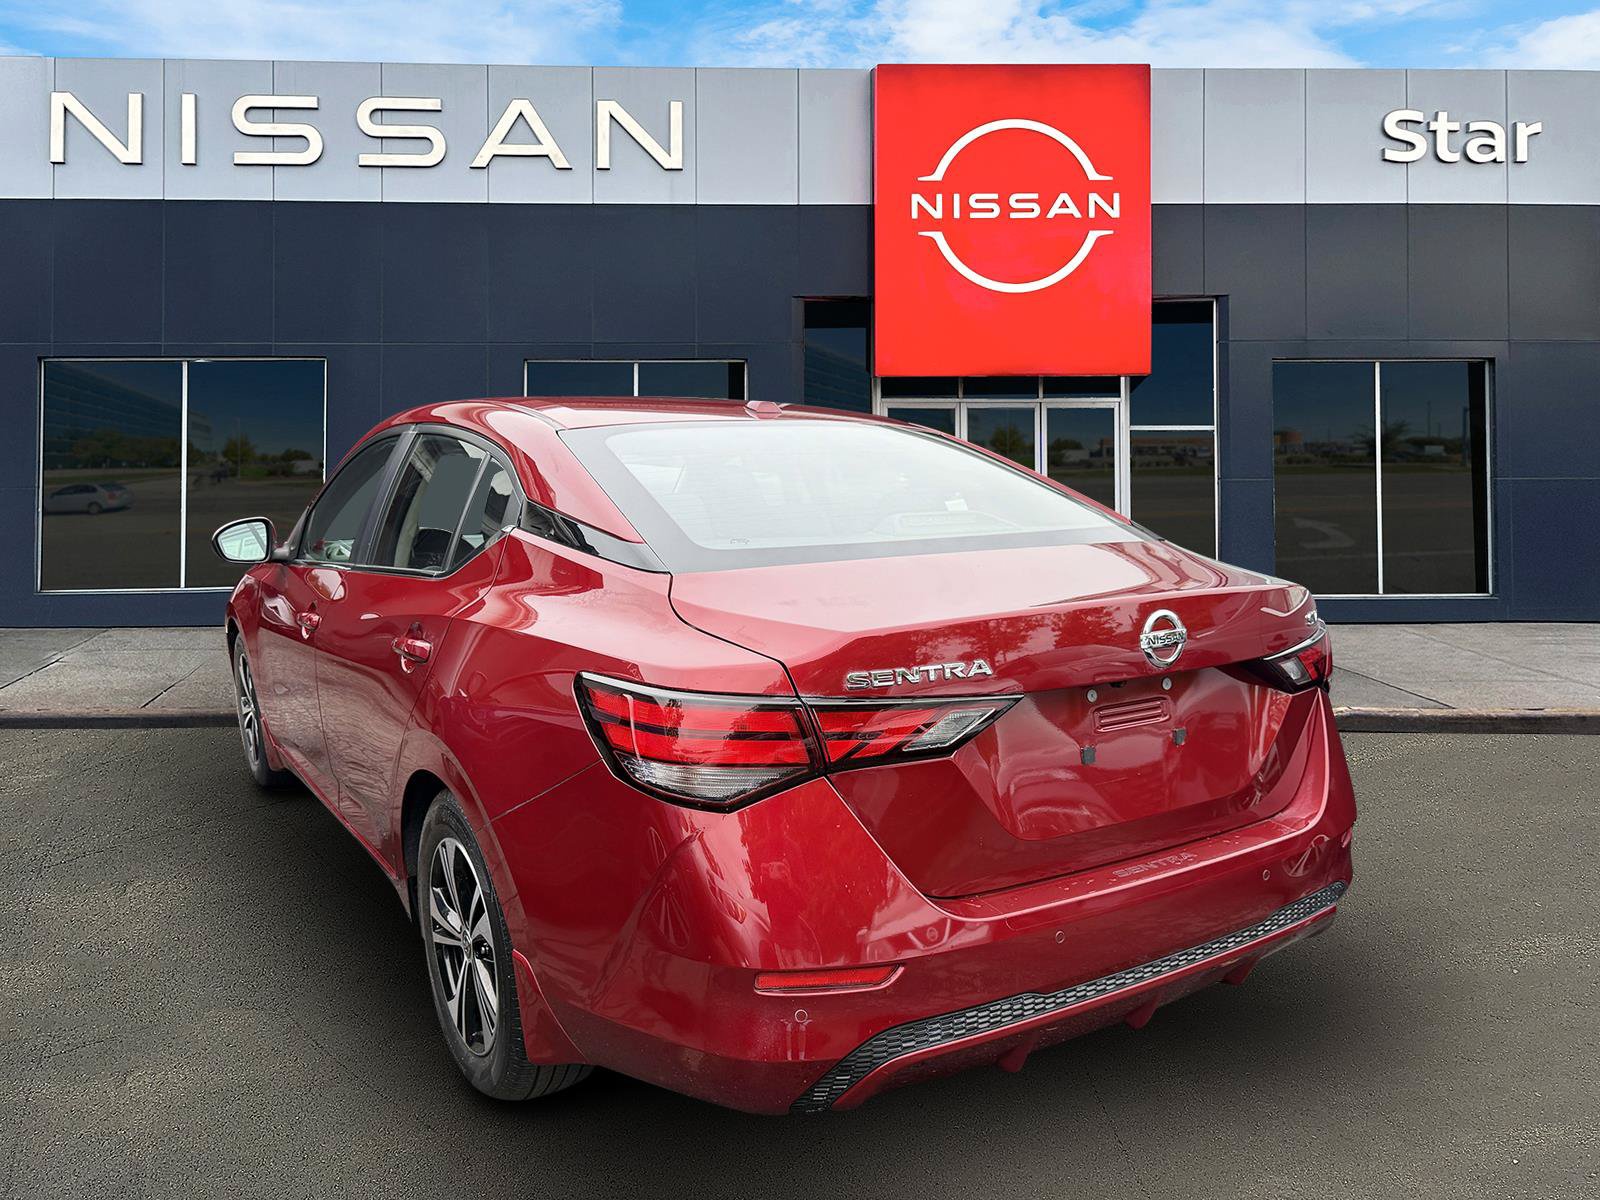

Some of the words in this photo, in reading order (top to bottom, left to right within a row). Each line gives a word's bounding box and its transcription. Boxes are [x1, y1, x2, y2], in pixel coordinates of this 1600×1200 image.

[50, 91, 684, 170] NISSAN
[1382, 108, 1542, 164] Star
[911, 191, 1121, 220] NISSAN
[1147, 631, 1184, 646] NISSAN
[846, 659, 993, 690] SENTRA
[1112, 852, 1197, 877] SENTRA
